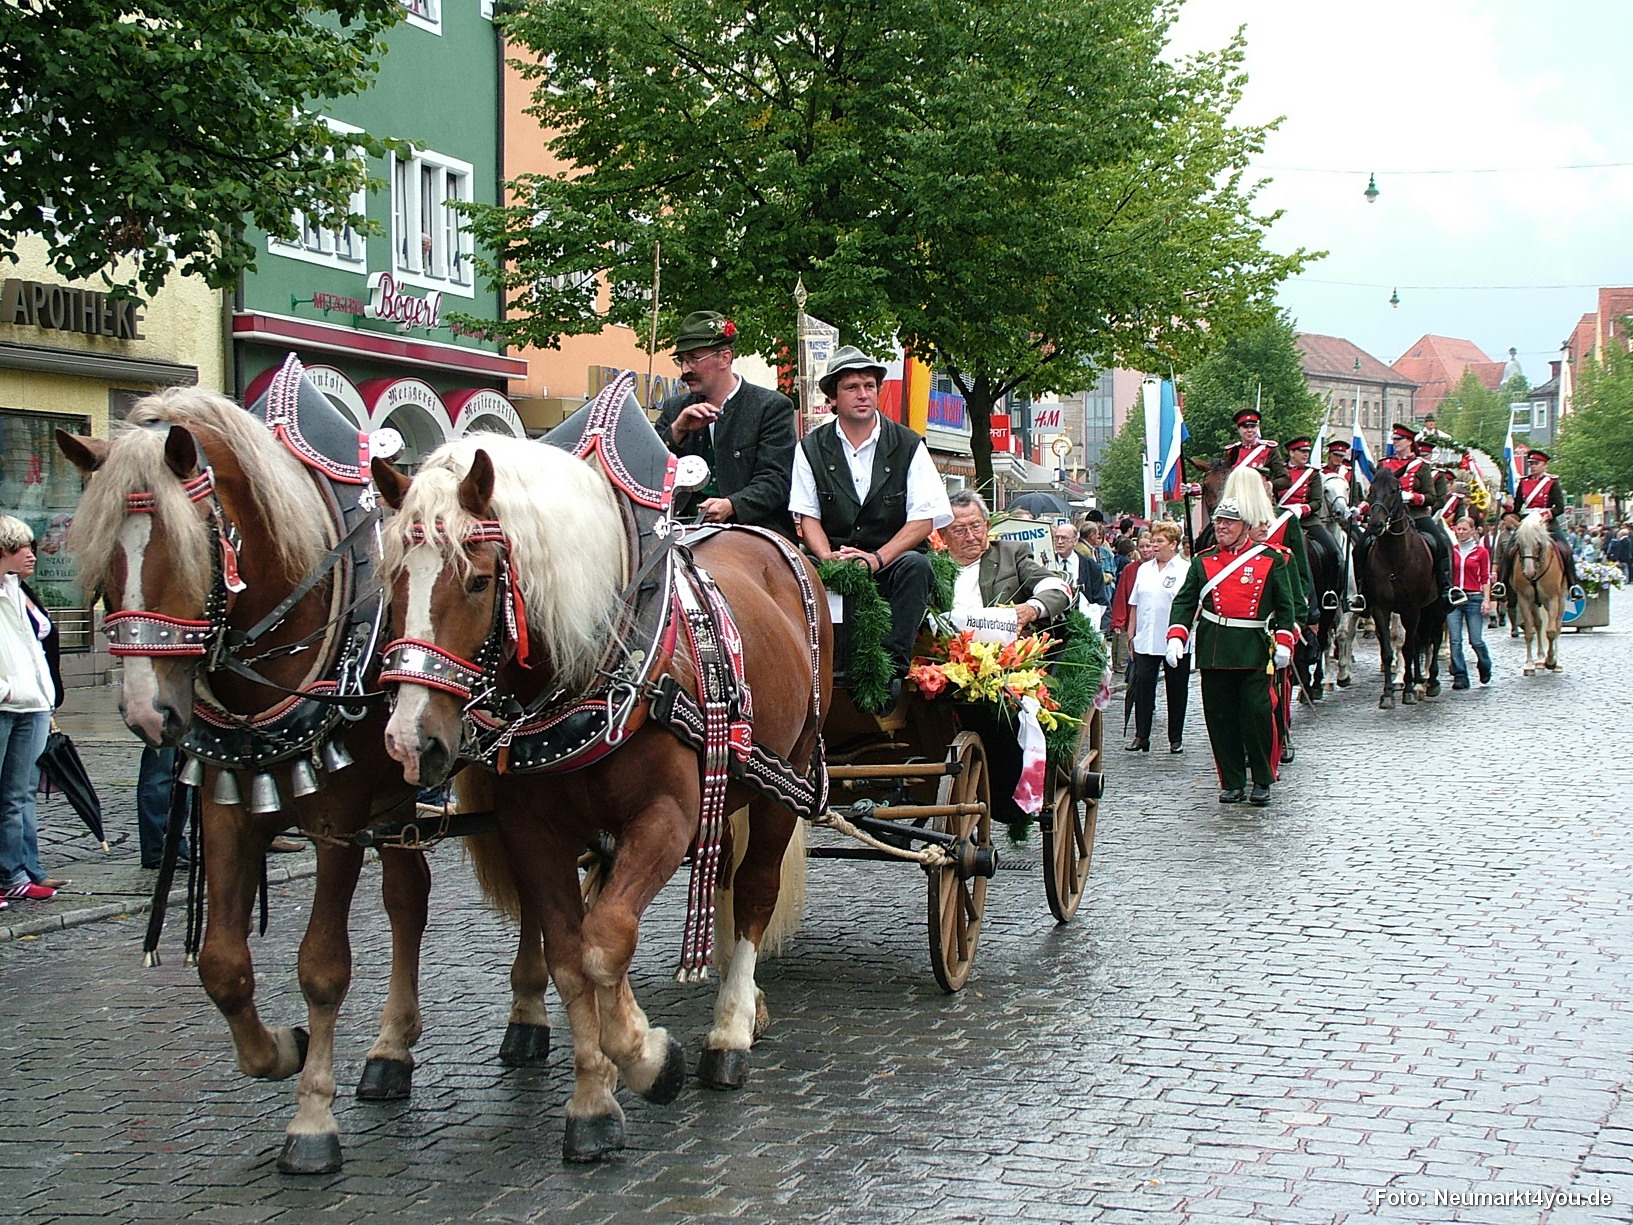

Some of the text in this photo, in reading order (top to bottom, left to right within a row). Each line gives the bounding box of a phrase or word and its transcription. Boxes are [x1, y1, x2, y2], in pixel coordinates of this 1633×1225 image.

[12, 279, 146, 340] APOTHEKE
[374, 272, 442, 332] Bögerl
[1034, 409, 1061, 428] H&M
